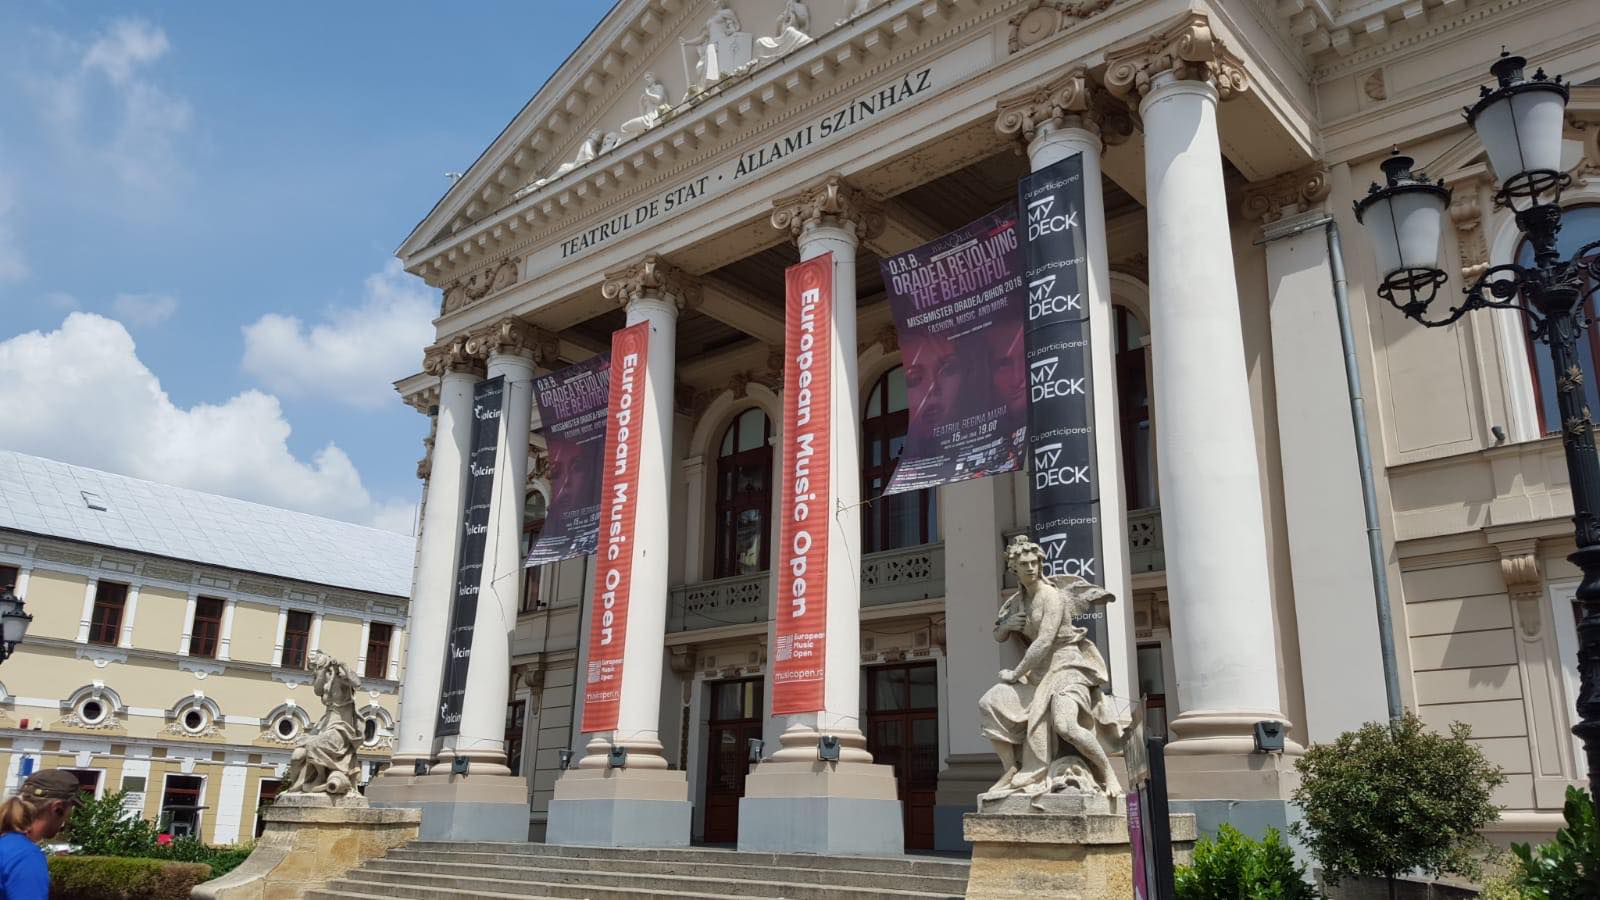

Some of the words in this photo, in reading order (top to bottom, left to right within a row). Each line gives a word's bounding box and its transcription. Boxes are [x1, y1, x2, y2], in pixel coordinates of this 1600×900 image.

[560, 214, 632, 258] TEATRUL
[635, 199, 659, 224] DE
[664, 176, 709, 211] STAT
[734, 126, 814, 180] ÁLLAMI
[820, 68, 931, 138] SZÍNHÁZ
[1027, 201, 1054, 226] MY
[1028, 211, 1079, 242] DECK
[889, 253, 922, 275] O.R.B.
[892, 260, 949, 296] ORADEA
[947, 228, 1018, 279] REVOLVING
[910, 284, 939, 310] THE
[940, 256, 1010, 301] BEAUTIFUL
[1004, 275, 1022, 293] 2018
[1029, 280, 1056, 304] MY
[1029, 293, 1080, 320] DECK
[797, 287, 820, 428] European
[1030, 362, 1058, 386] MY
[1031, 377, 1085, 403] DECK
[614, 352, 639, 476] European
[1035, 449, 1062, 472] MY
[795, 432, 818, 522] Music
[1035, 466, 1090, 490] DECK
[607, 483, 629, 561] Music
[790, 530, 813, 618] Open
[600, 568, 621, 646] Open
